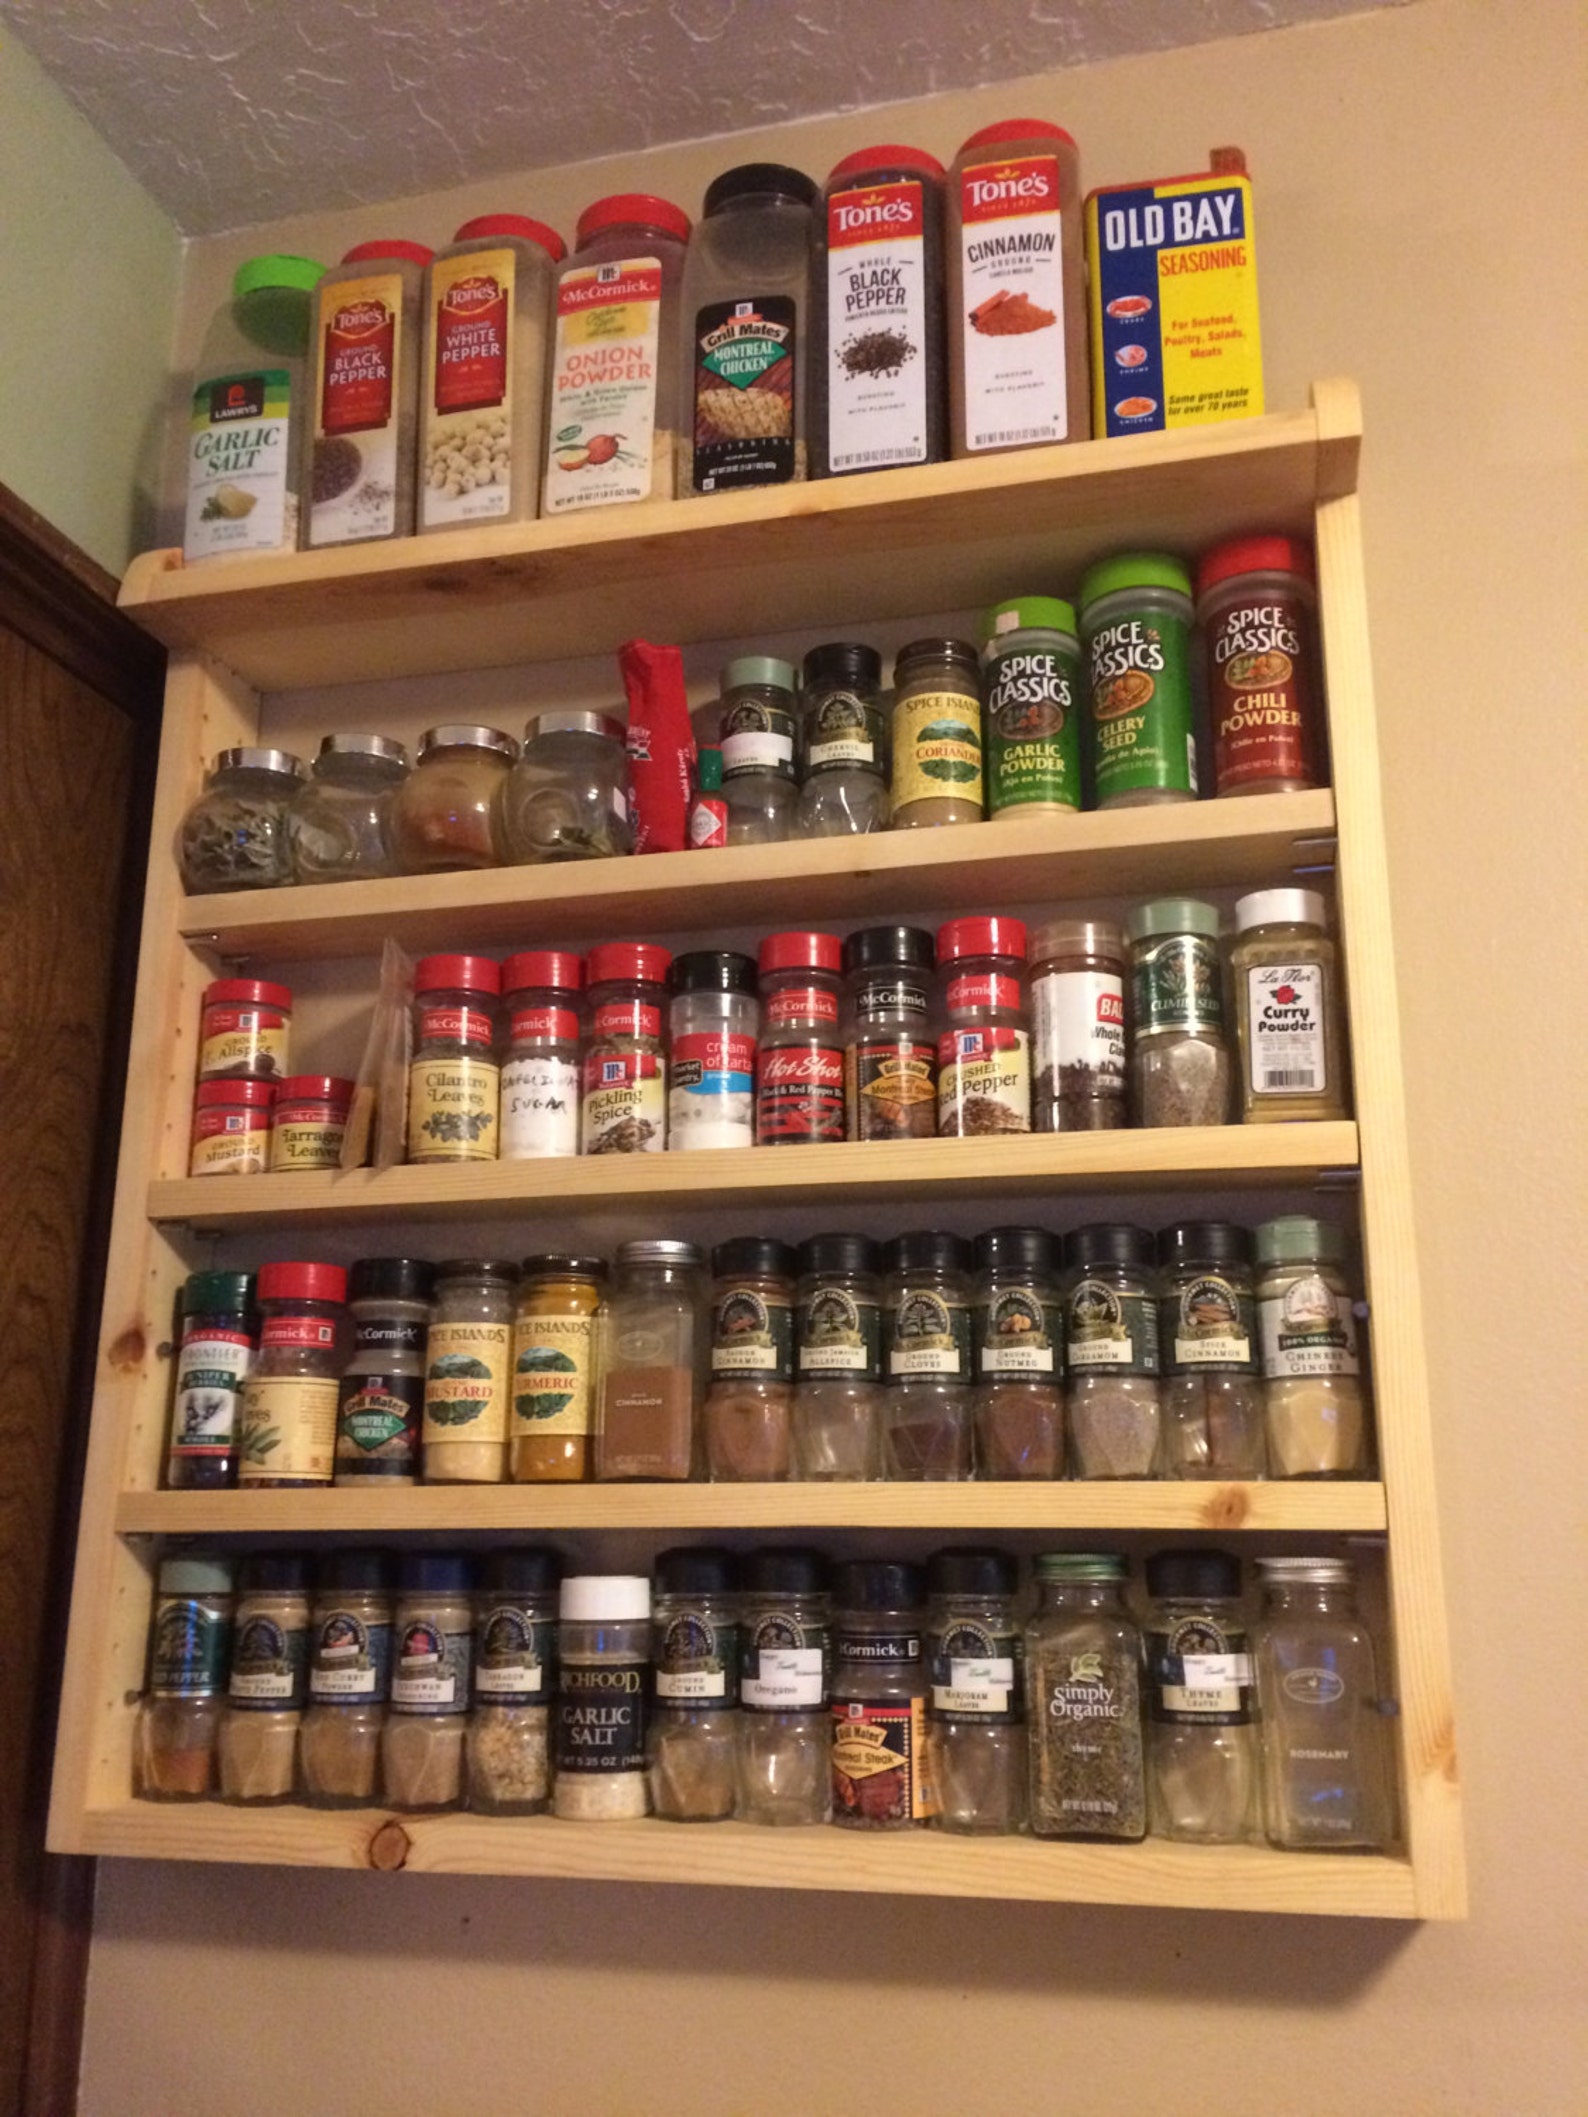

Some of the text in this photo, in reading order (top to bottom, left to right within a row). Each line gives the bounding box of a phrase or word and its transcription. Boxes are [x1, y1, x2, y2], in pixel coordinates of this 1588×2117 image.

[967, 172, 1049, 207] Tone's
[833, 197, 913, 231] Tone's
[1104, 194, 1235, 251] OLD BAY
[967, 232, 1056, 263] CINNAMON
[1160, 246, 1247, 277] SEASONING
[850, 267, 903, 292] BLACK
[563, 279, 650, 304] McCormick
[845, 287, 907, 313] PEPPER
[1172, 320, 1188, 331] For
[446, 328, 496, 348] WHITE
[707, 323, 782, 348] Grill Mates
[442, 343, 499, 364] PEPPER
[566, 345, 644, 372] ONION
[714, 341, 775, 362] MONTREAL
[335, 352, 382, 371] BLACK
[720, 358, 769, 376] CHICKEN
[330, 366, 387, 386] PEPPER
[558, 364, 651, 392] POWDER
[1197, 390, 1224, 403] great
[1225, 387, 1249, 398] taste
[1168, 405, 1182, 415] for
[1184, 404, 1204, 414] over
[1221, 399, 1248, 411] years
[195, 426, 280, 459] GARLIC
[206, 450, 261, 477] SALT
[1227, 607, 1285, 634] SPICE
[1092, 621, 1144, 660] SPICE
[1215, 627, 1300, 663] CLASSICS
[1000, 655, 1058, 683] SPICE
[989, 677, 1072, 714] CLASSICS
[1233, 693, 1287, 712] CHILI
[906, 698, 944, 714] SPICE
[1098, 716, 1146, 742] CELERY
[1220, 710, 1302, 737] POWDER
[1102, 731, 1137, 753] SEED
[1004, 744, 1060, 761] GARLIC
[1000, 758, 1065, 776] POWDER
[1258, 969, 1312, 984] La Flor
[1263, 1006, 1309, 1021] Curry
[427, 1018, 490, 1034] McComick
[1091, 1026, 1120, 1041] Whole
[1258, 1020, 1316, 1032] Powder
[219, 1044, 272, 1059] Allspce
[706, 1055, 721, 1068] of
[764, 1056, 841, 1080] Hot Shot
[788, 1084, 806, 1095] Red
[963, 1073, 1019, 1095] Pepper
[588, 1089, 643, 1113] Pickling
[593, 1105, 633, 1125] Spice
[450, 1328, 505, 1343] ISLANDS
[535, 1321, 591, 1335] ISLANDS
[995, 1359, 1038, 1367] NUTMEG
[1184, 1350, 1241, 1358] CINNAMON
[904, 1360, 941, 1369] CLOVES
[1290, 1362, 1342, 1373] GINGER
[426, 1386, 493, 1399] MUSTARD
[668, 1684, 705, 1692] CUMIN
[754, 1684, 797, 1696] Oregano
[944, 1689, 988, 1700] MARJORAM
[1054, 1683, 1114, 1706] Simply
[1181, 1688, 1222, 1698] THYME
[562, 1706, 631, 1725] GARLIC
[1050, 1700, 1120, 1720] Organic
[570, 1727, 618, 1745] SALT
[601, 1756, 616, 1766] OZ
[865, 1752, 893, 1764] Steak
[1289, 1749, 1349, 1760] ROSEMARY
